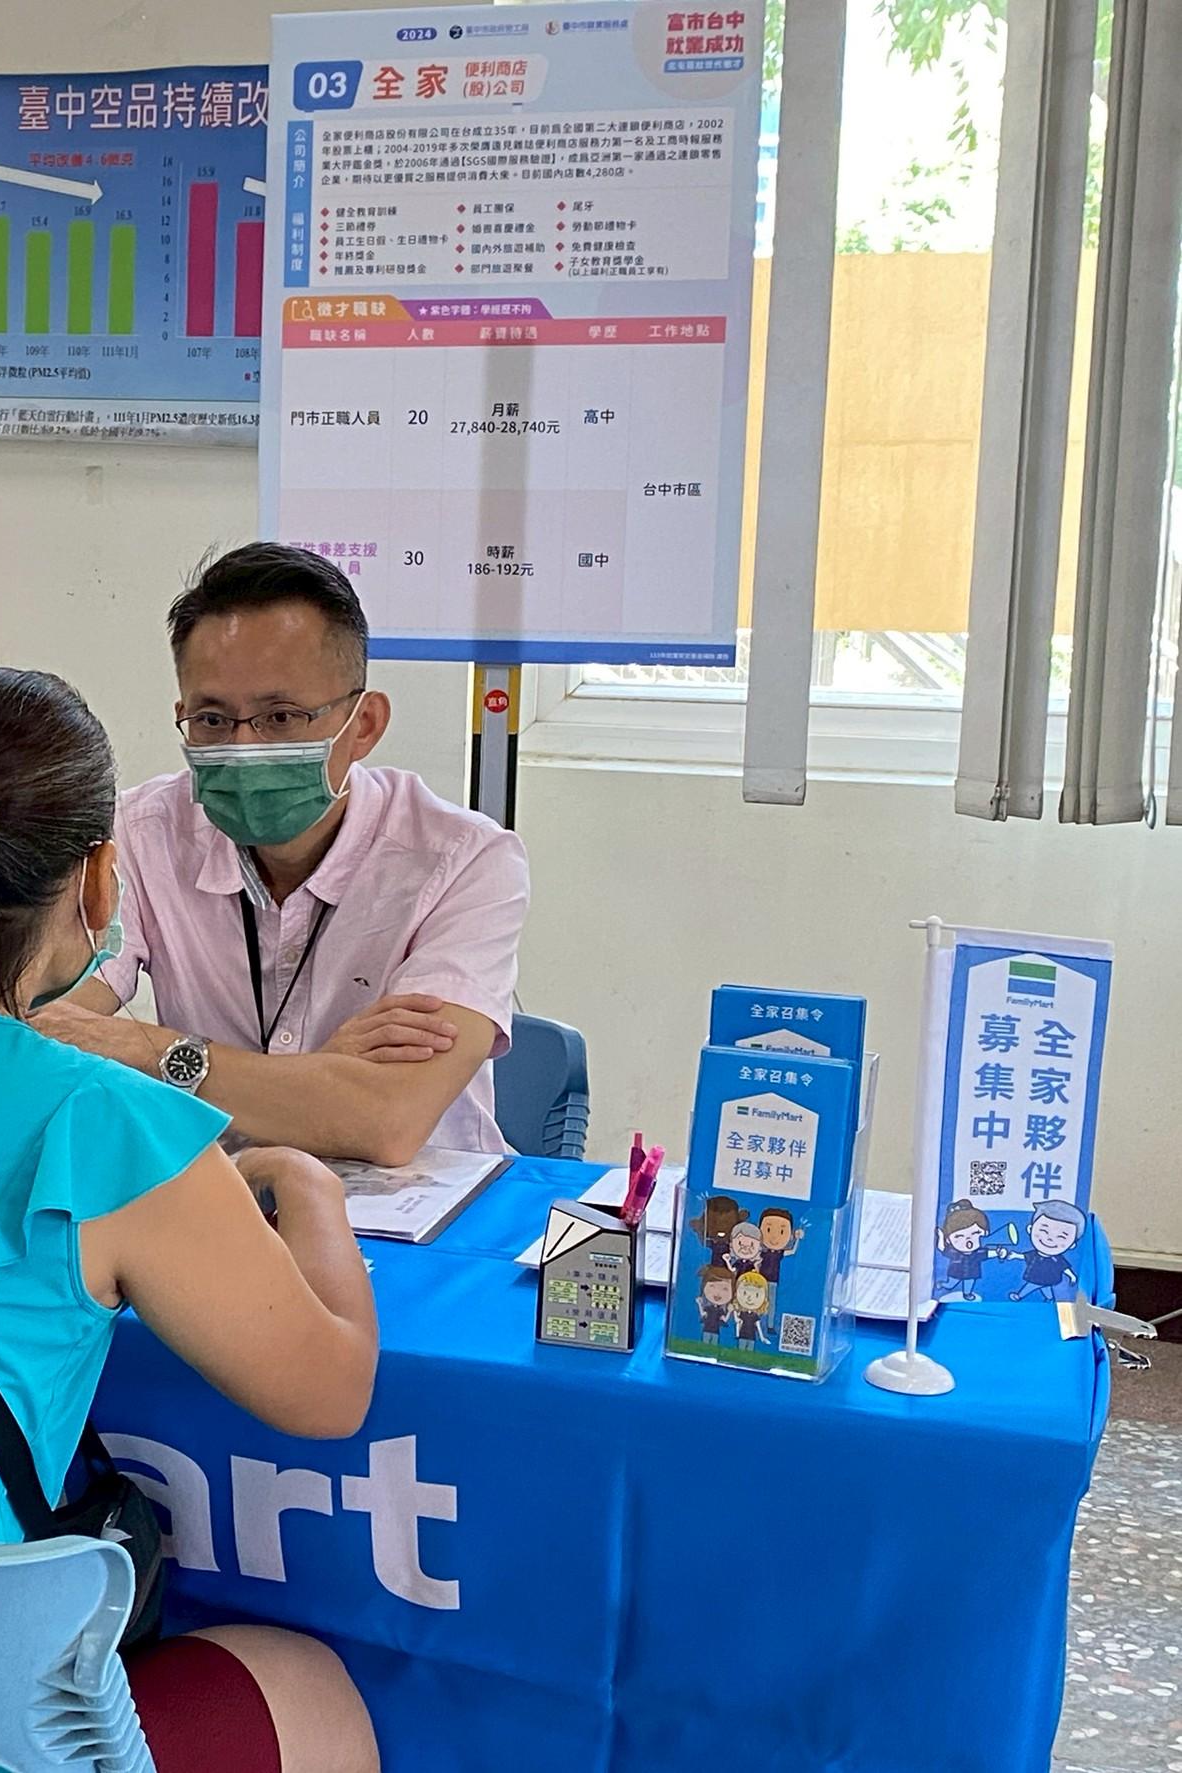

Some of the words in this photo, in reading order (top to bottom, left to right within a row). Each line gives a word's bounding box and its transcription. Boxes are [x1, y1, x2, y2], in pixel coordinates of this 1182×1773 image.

[666, 10, 746, 31] 富市台中
[401, 29, 432, 40] 2024
[665, 34, 745, 55] 就業成功
[465, 60, 528, 79] 便利商店
[308, 71, 347, 99] 03
[372, 64, 449, 100] 全家
[462, 79, 525, 98] (股)公司
[17, 81, 268, 132] 臺中空品持續改
[292, 128, 307, 189] 公司簡介
[74, 205, 92, 216] 16.9
[335, 206, 398, 218] 健全教育訓練
[572, 201, 594, 212] 尾牙
[31, 216, 48, 227] 15.4
[161, 216, 171, 226] 12
[290, 212, 305, 272] 福利制度
[571, 241, 636, 252] 免費健康檢查
[334, 250, 375, 261] 年終獎金
[317, 301, 387, 317] 徵才職缺
[309, 328, 367, 342] 職缺名稱
[406, 327, 435, 341] 人數
[588, 324, 618, 340] 學歷
[648, 323, 711, 338] 工作地點
[25, 345, 50, 356] 109年
[187, 348, 211, 358] 107年
[491, 402, 520, 418] 月薪
[582, 409, 616, 425] 高中
[289, 410, 382, 427] 門市正職人員
[407, 410, 429, 426] 20
[449, 418, 561, 436] 27,840-28,740元
[642, 482, 703, 498] 台中市區
[289, 542, 378, 557] 性兼差支援
[486, 545, 516, 560] 時薪
[403, 550, 425, 566] 30
[577, 552, 609, 569] 國中
[466, 563, 534, 577] 186-192元
[1006, 996, 1054, 1009] FamilyMart
[750, 1004, 824, 1021] 全家召集令
[739, 1066, 814, 1086] 全家召集令
[972, 1013, 1022, 1149] 募集中
[751, 1107, 803, 1122] FamilyMart
[1020, 1019, 1077, 1200] 全家夥伴
[726, 1131, 807, 1158] 全家夥伴
[733, 1158, 793, 1182] 招募中
